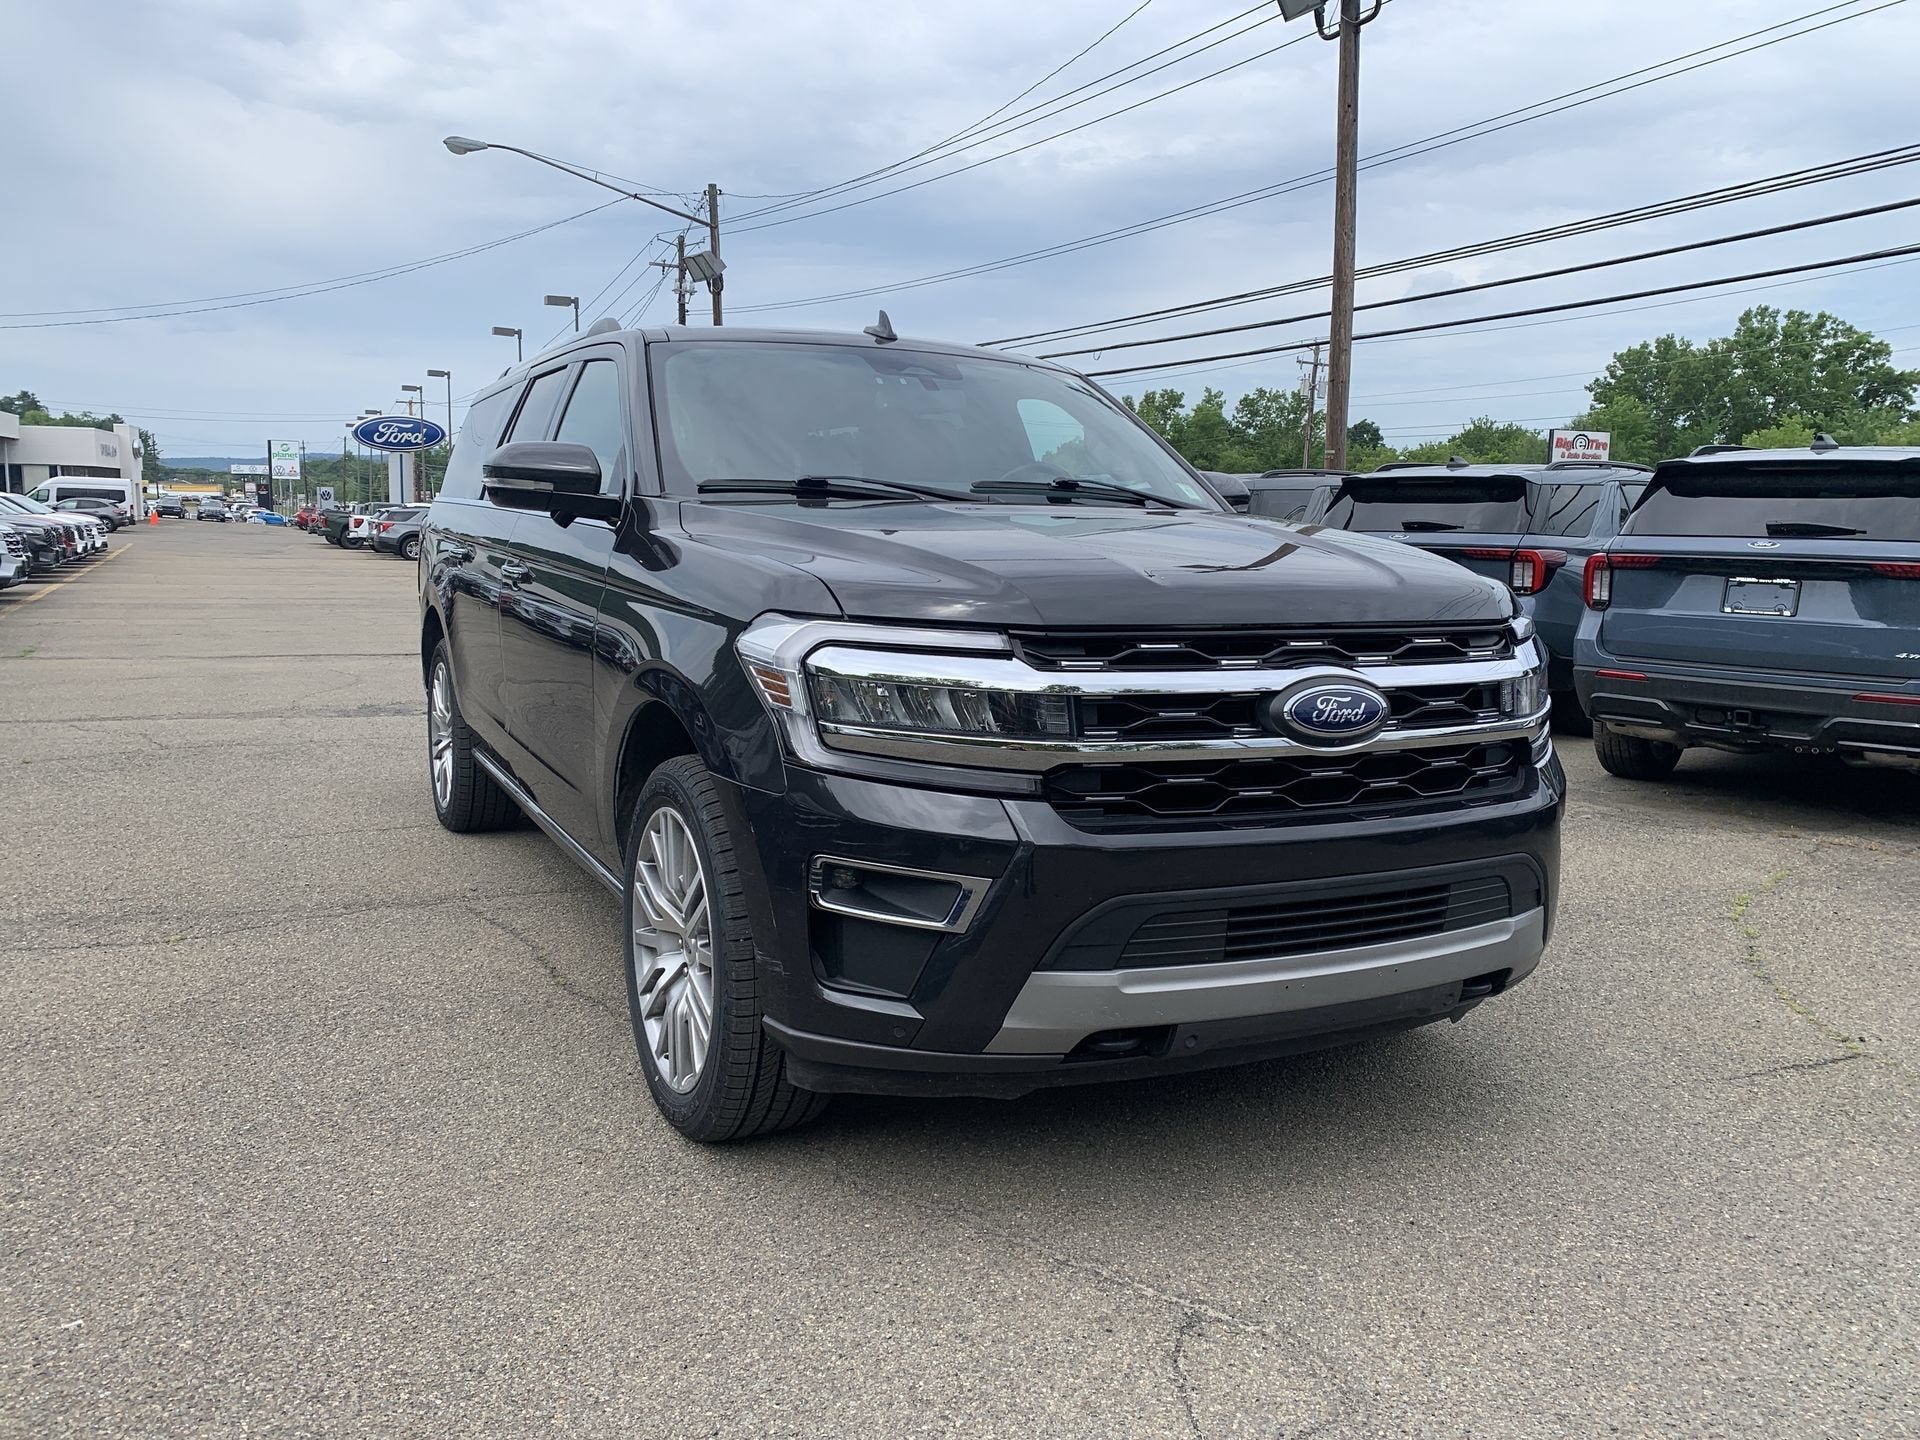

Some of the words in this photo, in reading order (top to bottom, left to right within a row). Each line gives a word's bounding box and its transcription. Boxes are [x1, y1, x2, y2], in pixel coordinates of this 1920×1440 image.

[373, 422, 426, 443] Ford
[1555, 437, 1573, 451] Big
[1589, 439, 1608, 451] Tire
[273, 451, 298, 459] planet
[1312, 695, 1366, 724] Ford
